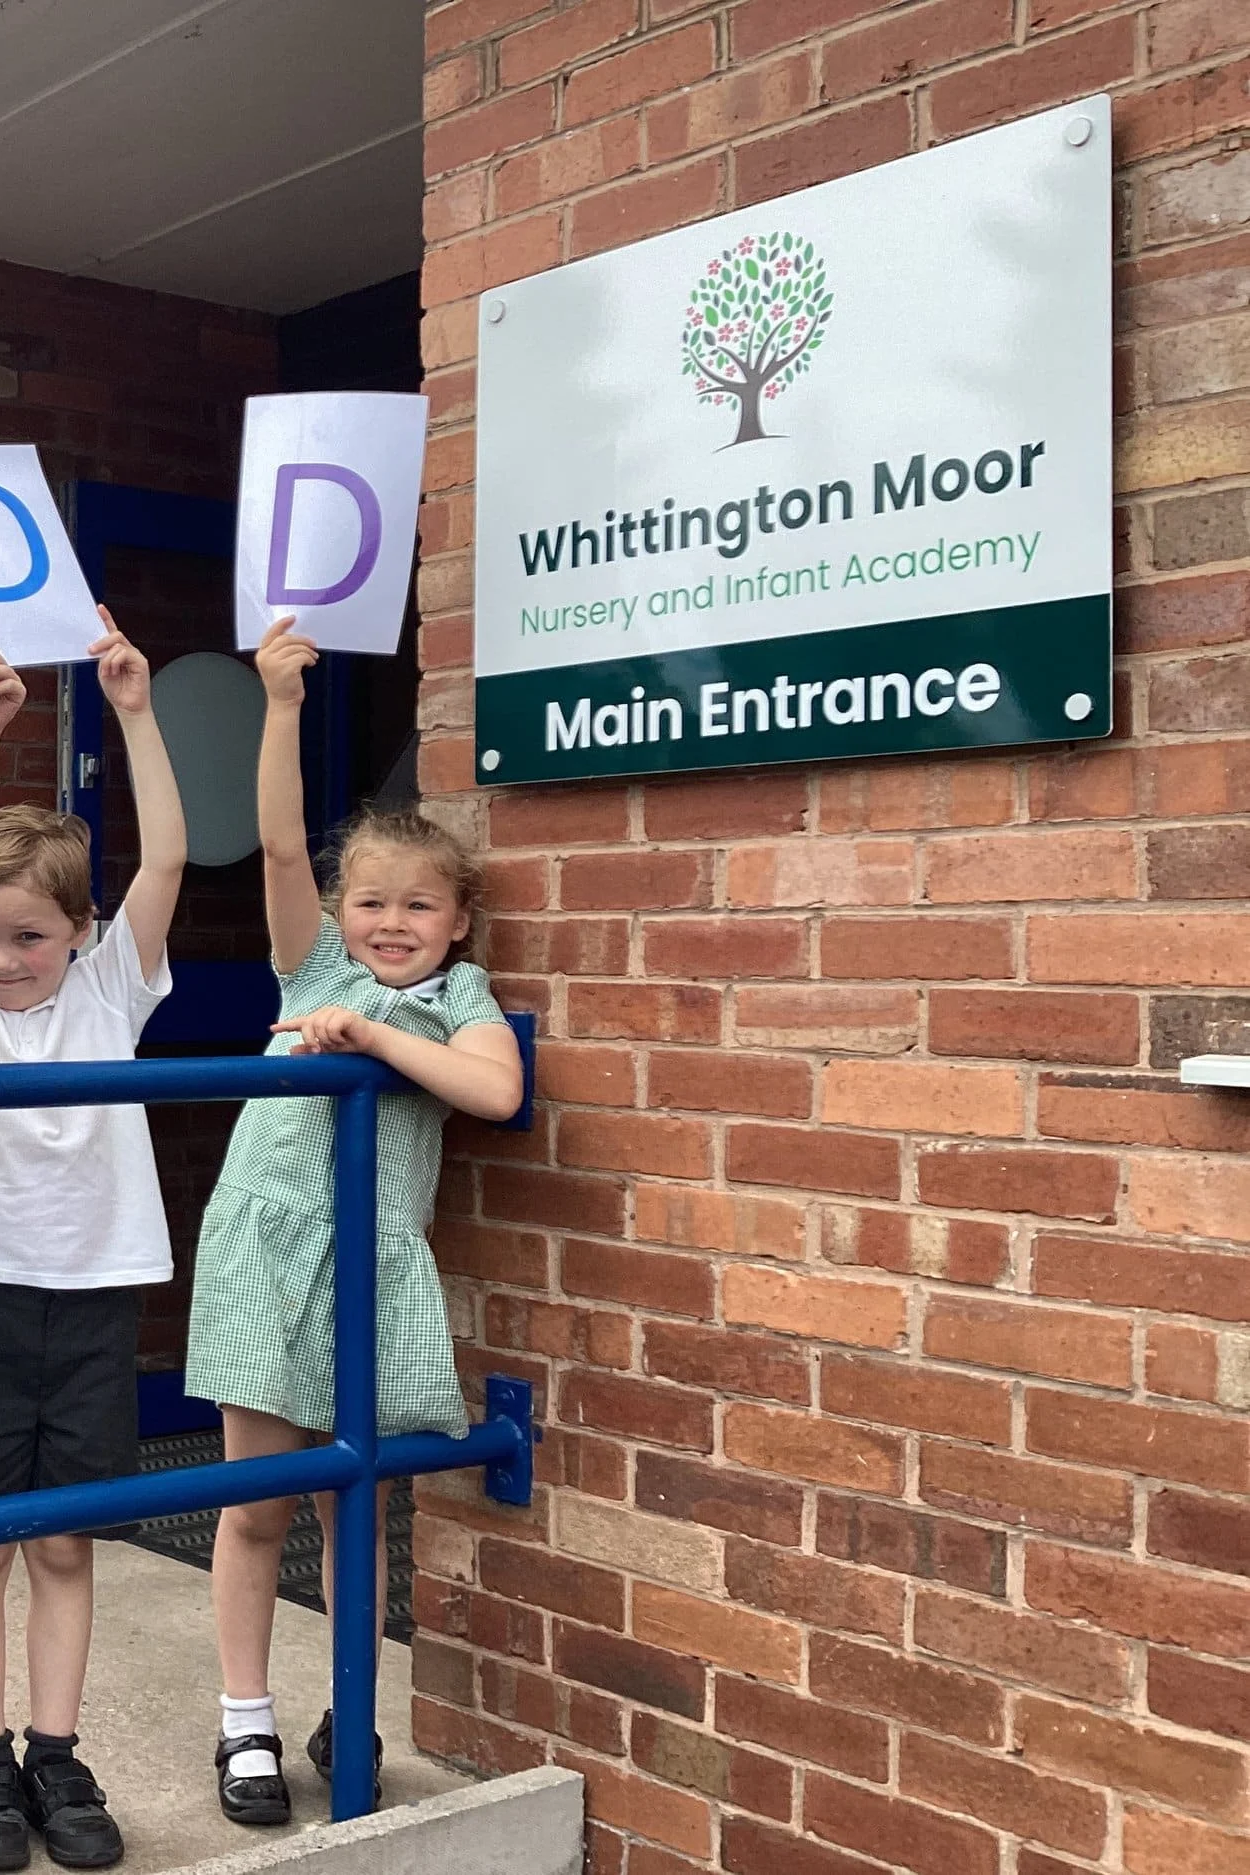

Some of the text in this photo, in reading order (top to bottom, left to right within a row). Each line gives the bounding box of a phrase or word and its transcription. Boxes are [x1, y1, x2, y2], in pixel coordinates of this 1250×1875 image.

[266, 463, 382, 606] D
[518, 440, 1046, 577] Whittington Moor
[520, 531, 1042, 636] Nursery and Infant Academy
[546, 663, 1001, 752] Main Entrance
